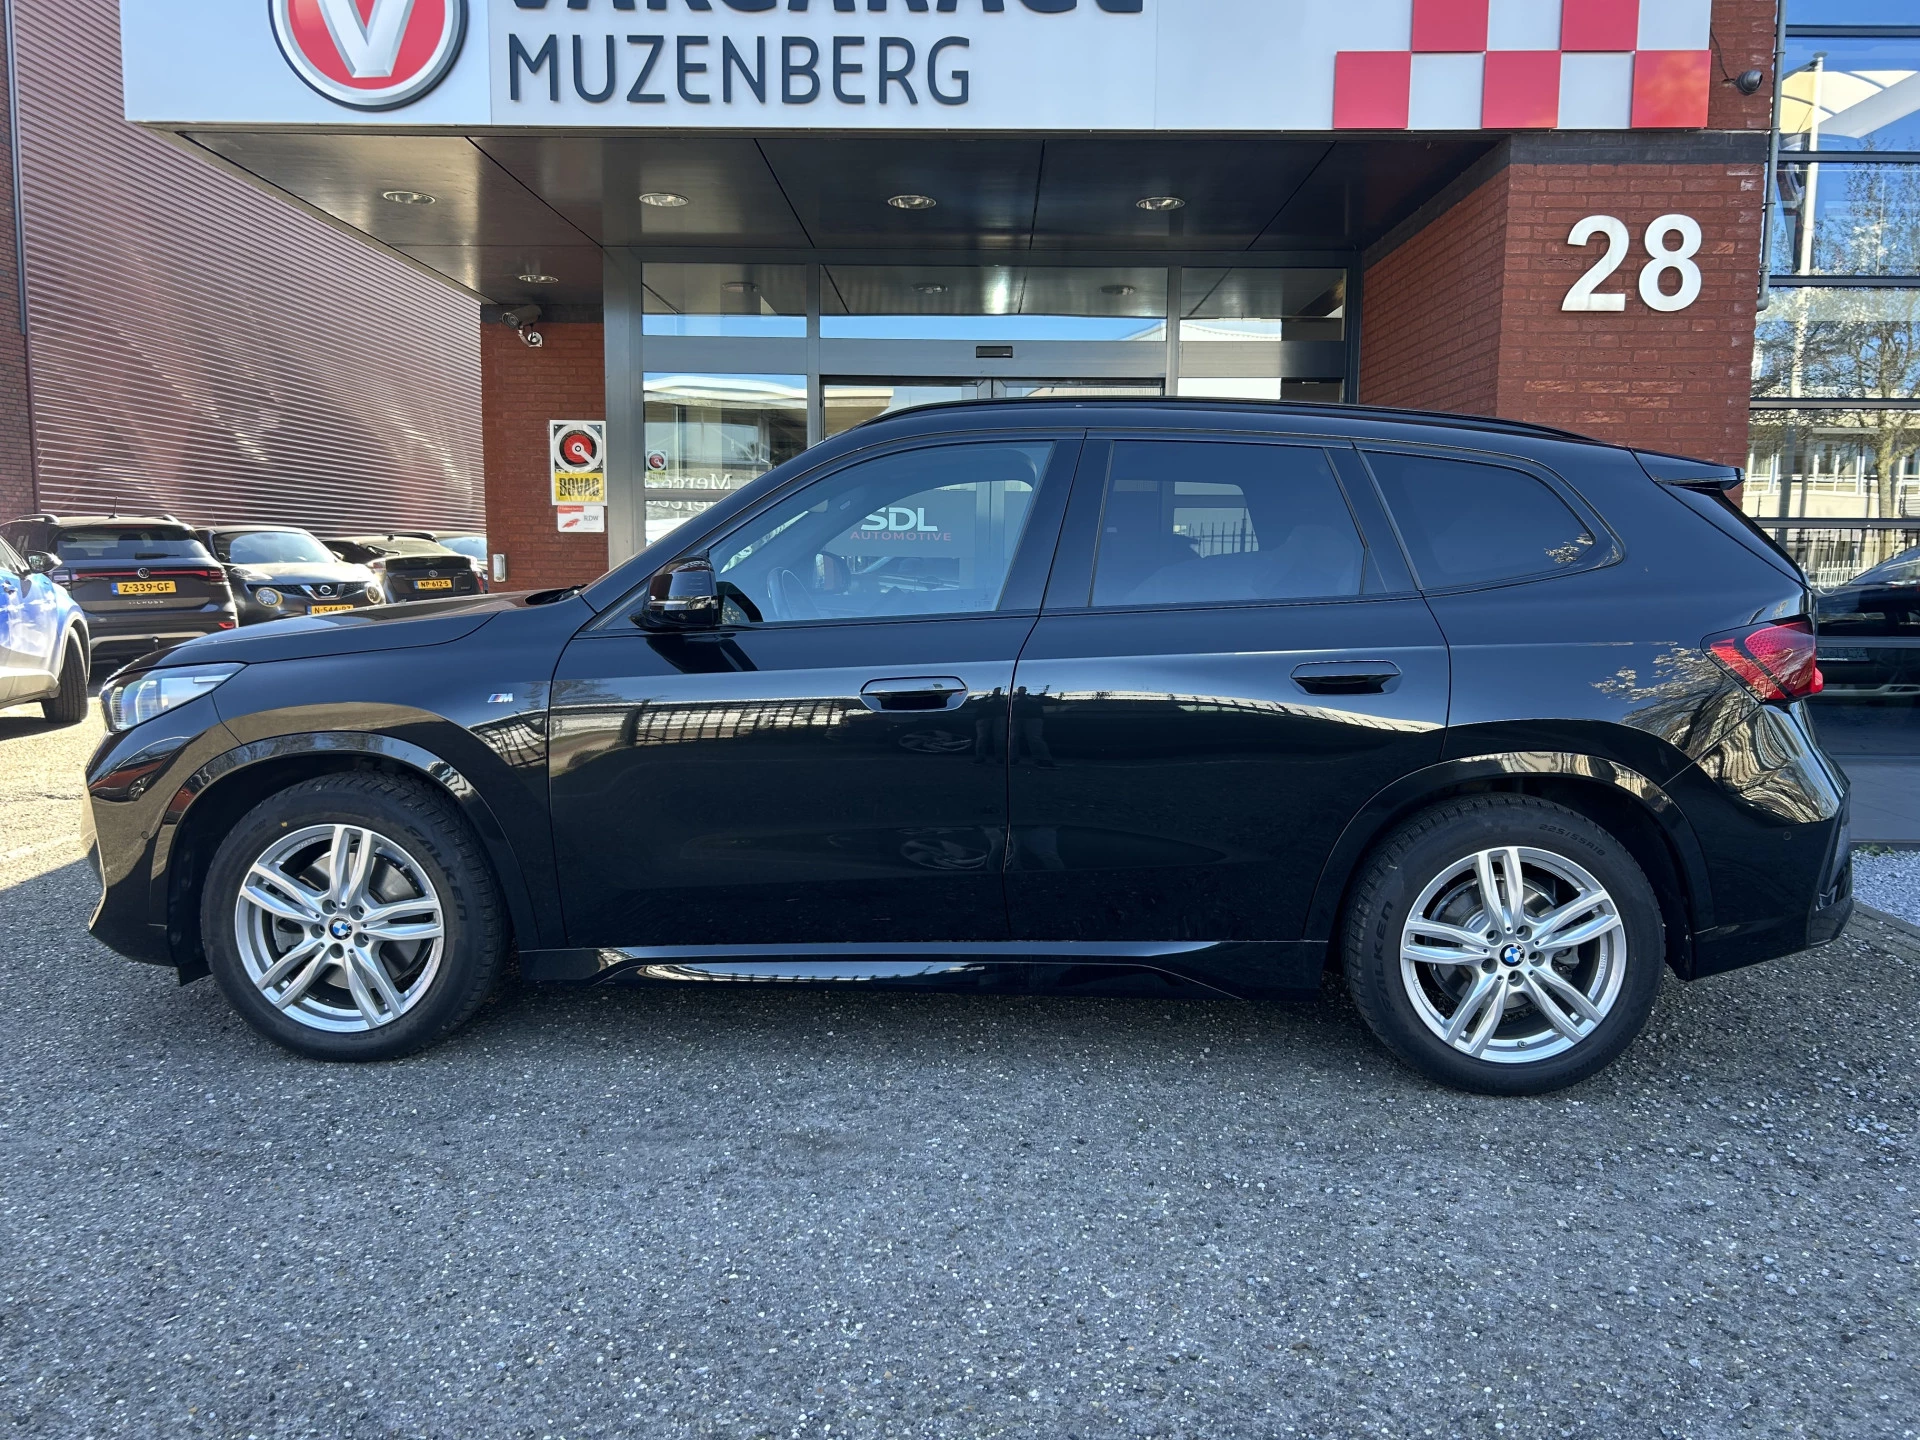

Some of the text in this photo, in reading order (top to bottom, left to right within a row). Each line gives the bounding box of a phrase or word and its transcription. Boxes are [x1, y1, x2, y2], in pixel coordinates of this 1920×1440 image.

[508, 33, 970, 105] MUZENBERG
[1561, 213, 1702, 312] 28
[850, 531, 952, 541] AUTOMOTIVE
[860, 507, 939, 532] SDL
[122, 582, 170, 593] Z-339-GF
[420, 580, 449, 588] NP-612-5
[404, 825, 468, 921] FALKEN
[1374, 900, 1396, 1014] FALKEN
